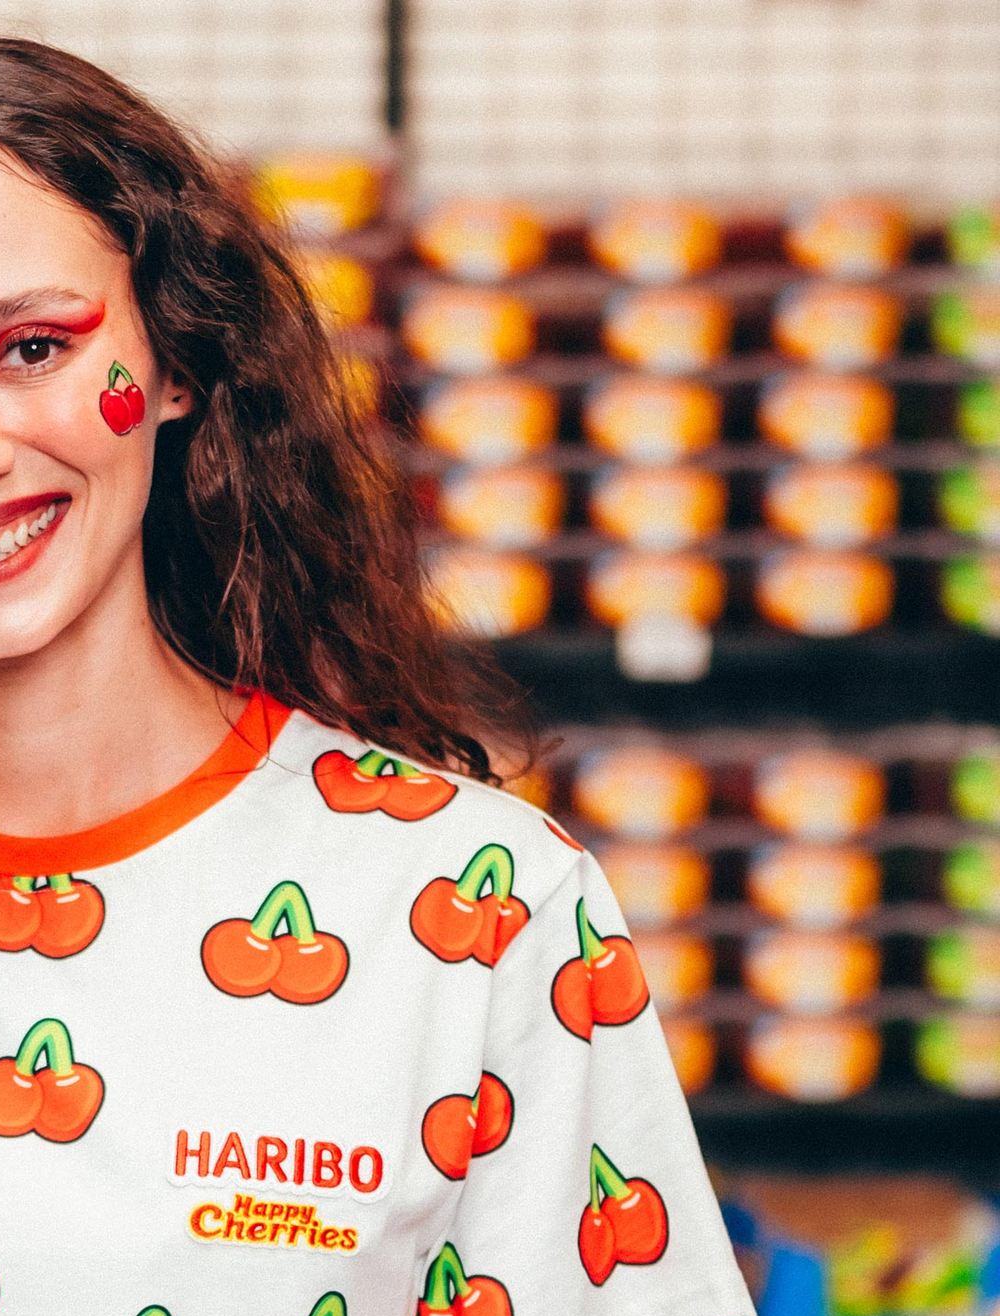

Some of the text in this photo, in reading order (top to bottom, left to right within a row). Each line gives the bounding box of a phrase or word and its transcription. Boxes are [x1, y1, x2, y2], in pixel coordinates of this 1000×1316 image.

[174, 1129, 384, 1194] HARIBO
[189, 1202, 359, 1251] Cherries
[233, 1193, 316, 1225] Happy
